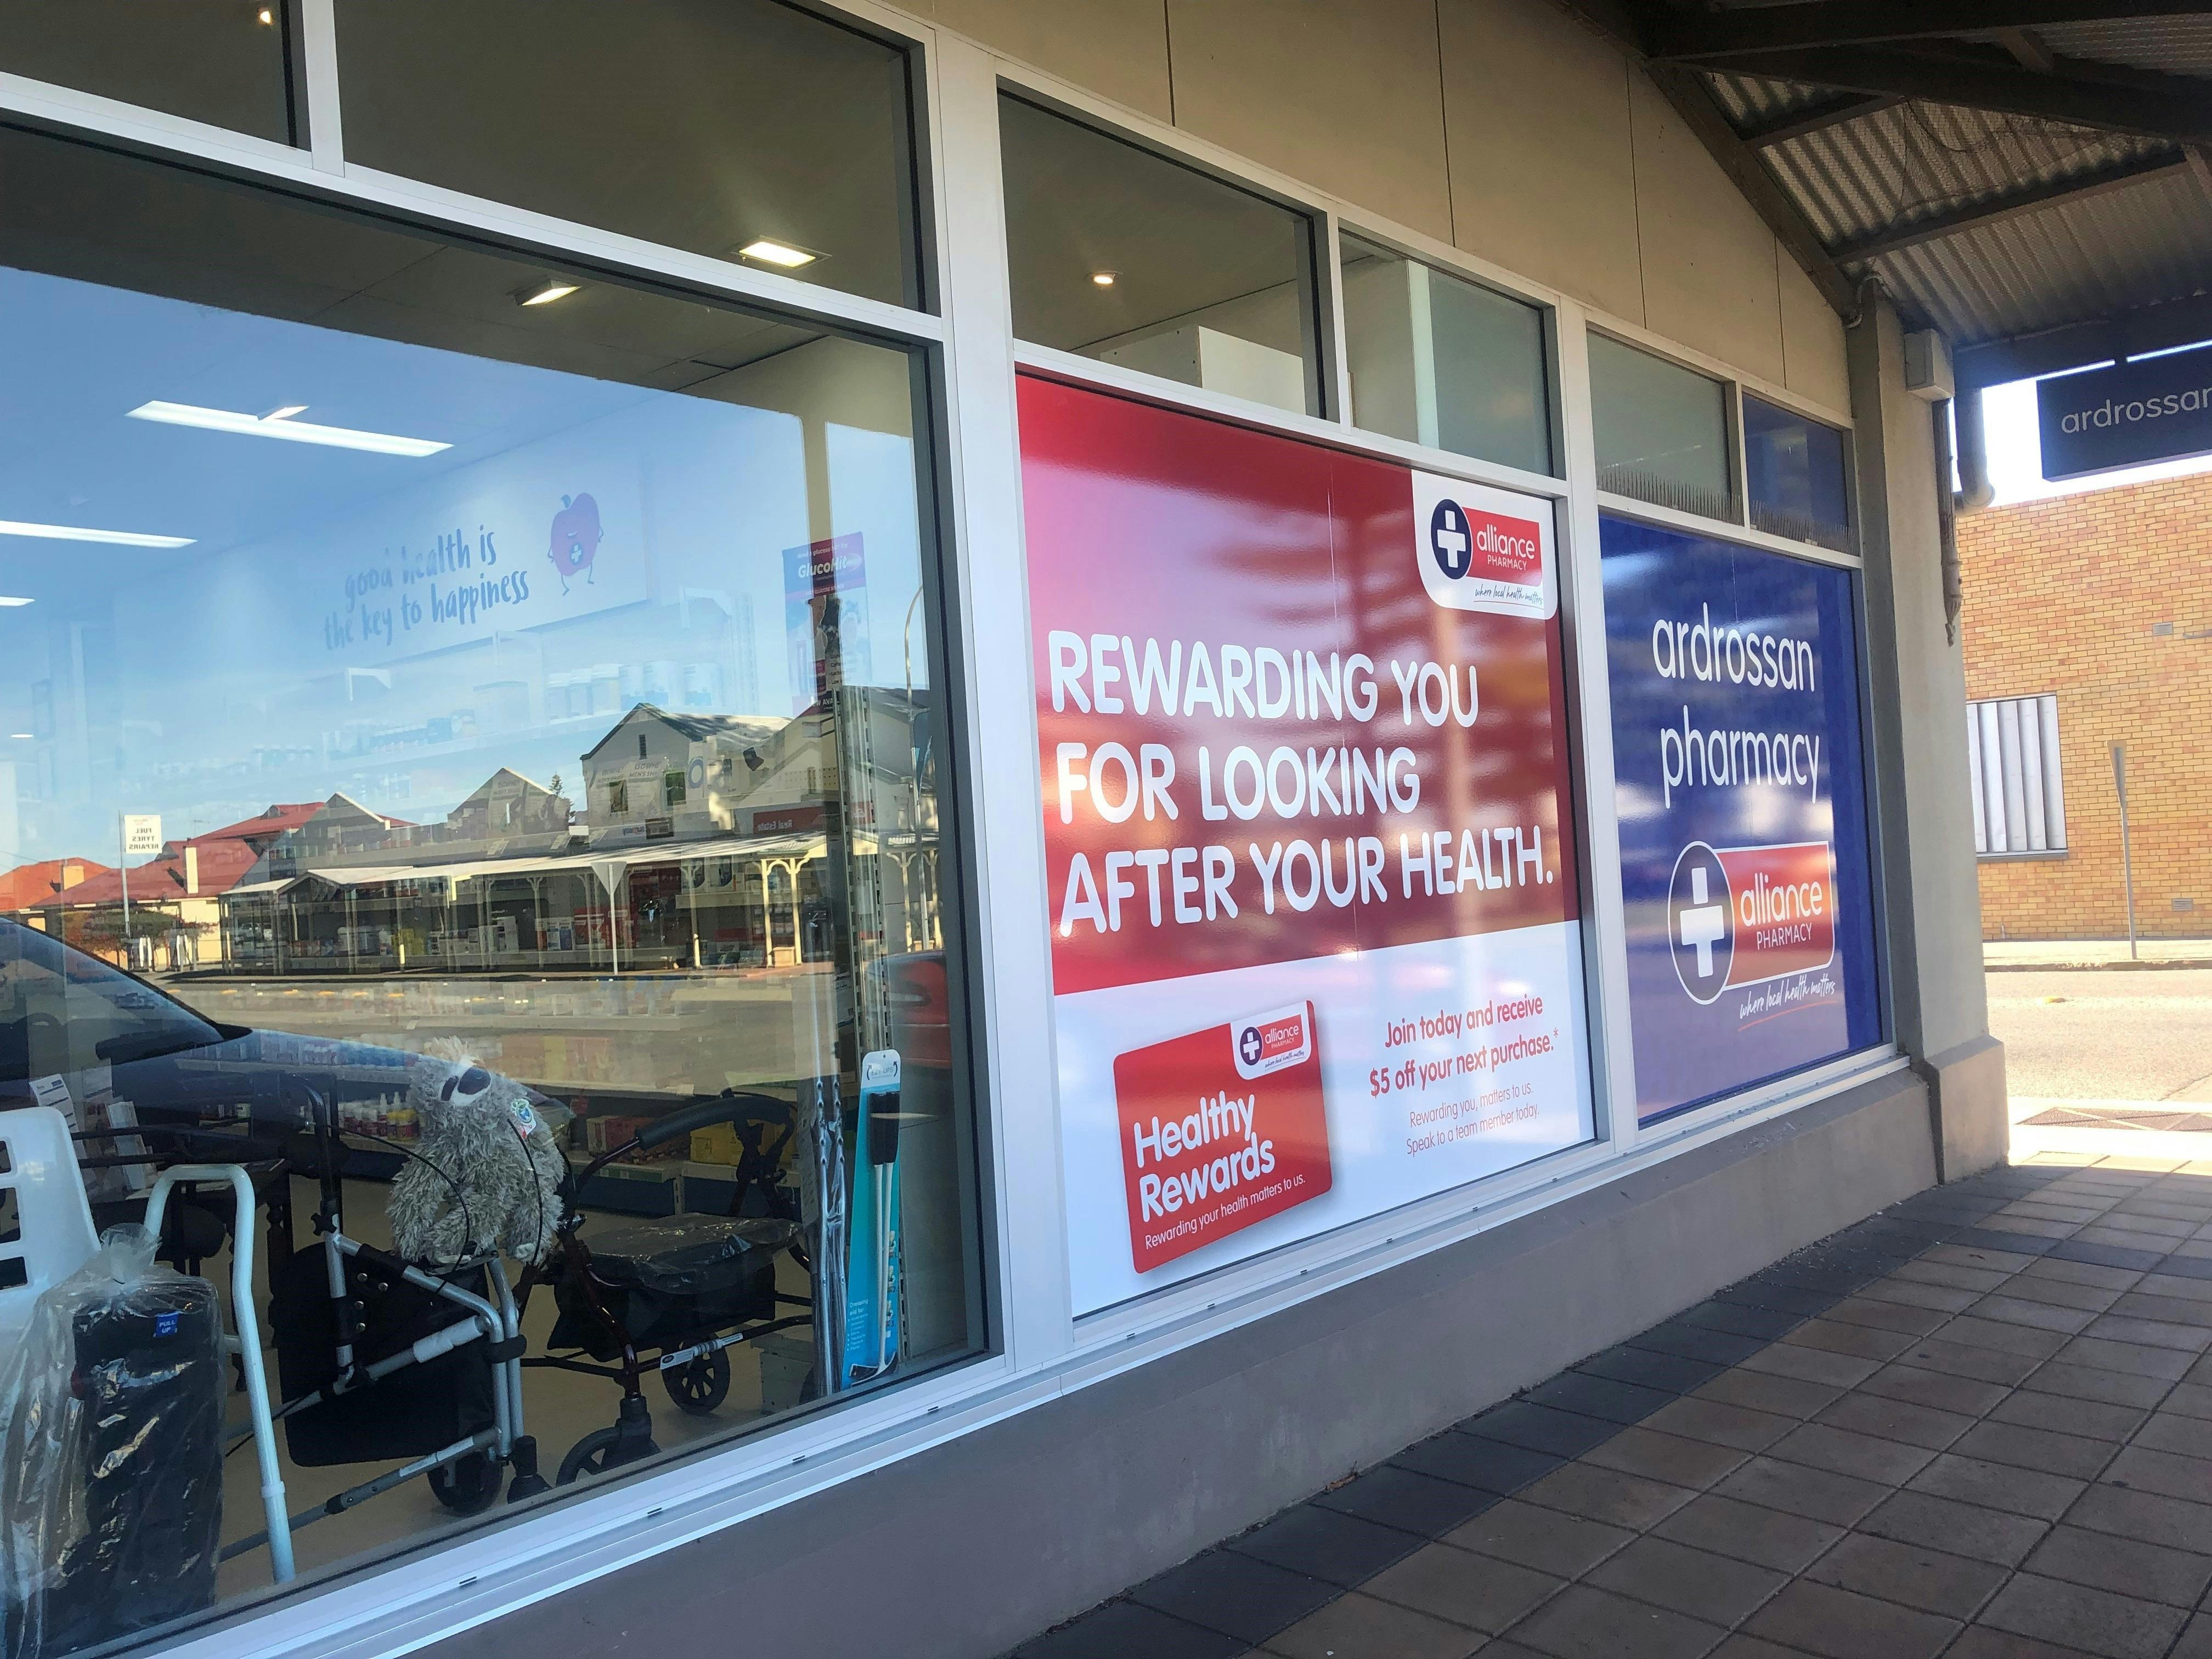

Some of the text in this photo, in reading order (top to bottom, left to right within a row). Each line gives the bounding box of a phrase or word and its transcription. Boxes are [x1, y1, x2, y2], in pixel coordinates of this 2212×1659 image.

[345, 524, 496, 613] good health is
[1476, 523, 1535, 560] alliance
[1487, 554, 1527, 571] PHARMACY
[324, 571, 529, 651] the key to happiness
[1475, 584, 1543, 605] where local health matters
[1652, 601, 1815, 692] ardrossan
[1048, 630, 1479, 728] REWARDING YOU
[1056, 741, 1421, 825] FOR LOOKING
[1660, 704, 1820, 809] pharmacy
[1059, 825, 1553, 938] AFTER YOUR HEALTH.
[1740, 872, 1823, 927] alliance
[1756, 922, 1813, 951] PHARMACY
[1384, 993, 1543, 1048] Join today and receive
[1739, 973, 1837, 1019] where local health matters
[1265, 1025, 1299, 1045] alliance
[1271, 1037, 1295, 1049] PHARMACY
[1369, 1067, 1390, 1098] $5
[1395, 1059, 1415, 1090] off
[1419, 1057, 1453, 1091] your
[1456, 1045, 1487, 1075] next
[1133, 1090, 1255, 1168] Healthy
[1406, 1102, 1541, 1158] Speak to a team member today.
[1409, 1081, 1534, 1128] Rewarding you, matters to us.
[1139, 1132, 1276, 1223] Rewards
[1145, 1173, 1306, 1250] Rewarding your health matters to us.
[159, 1319, 176, 1328] PULL
